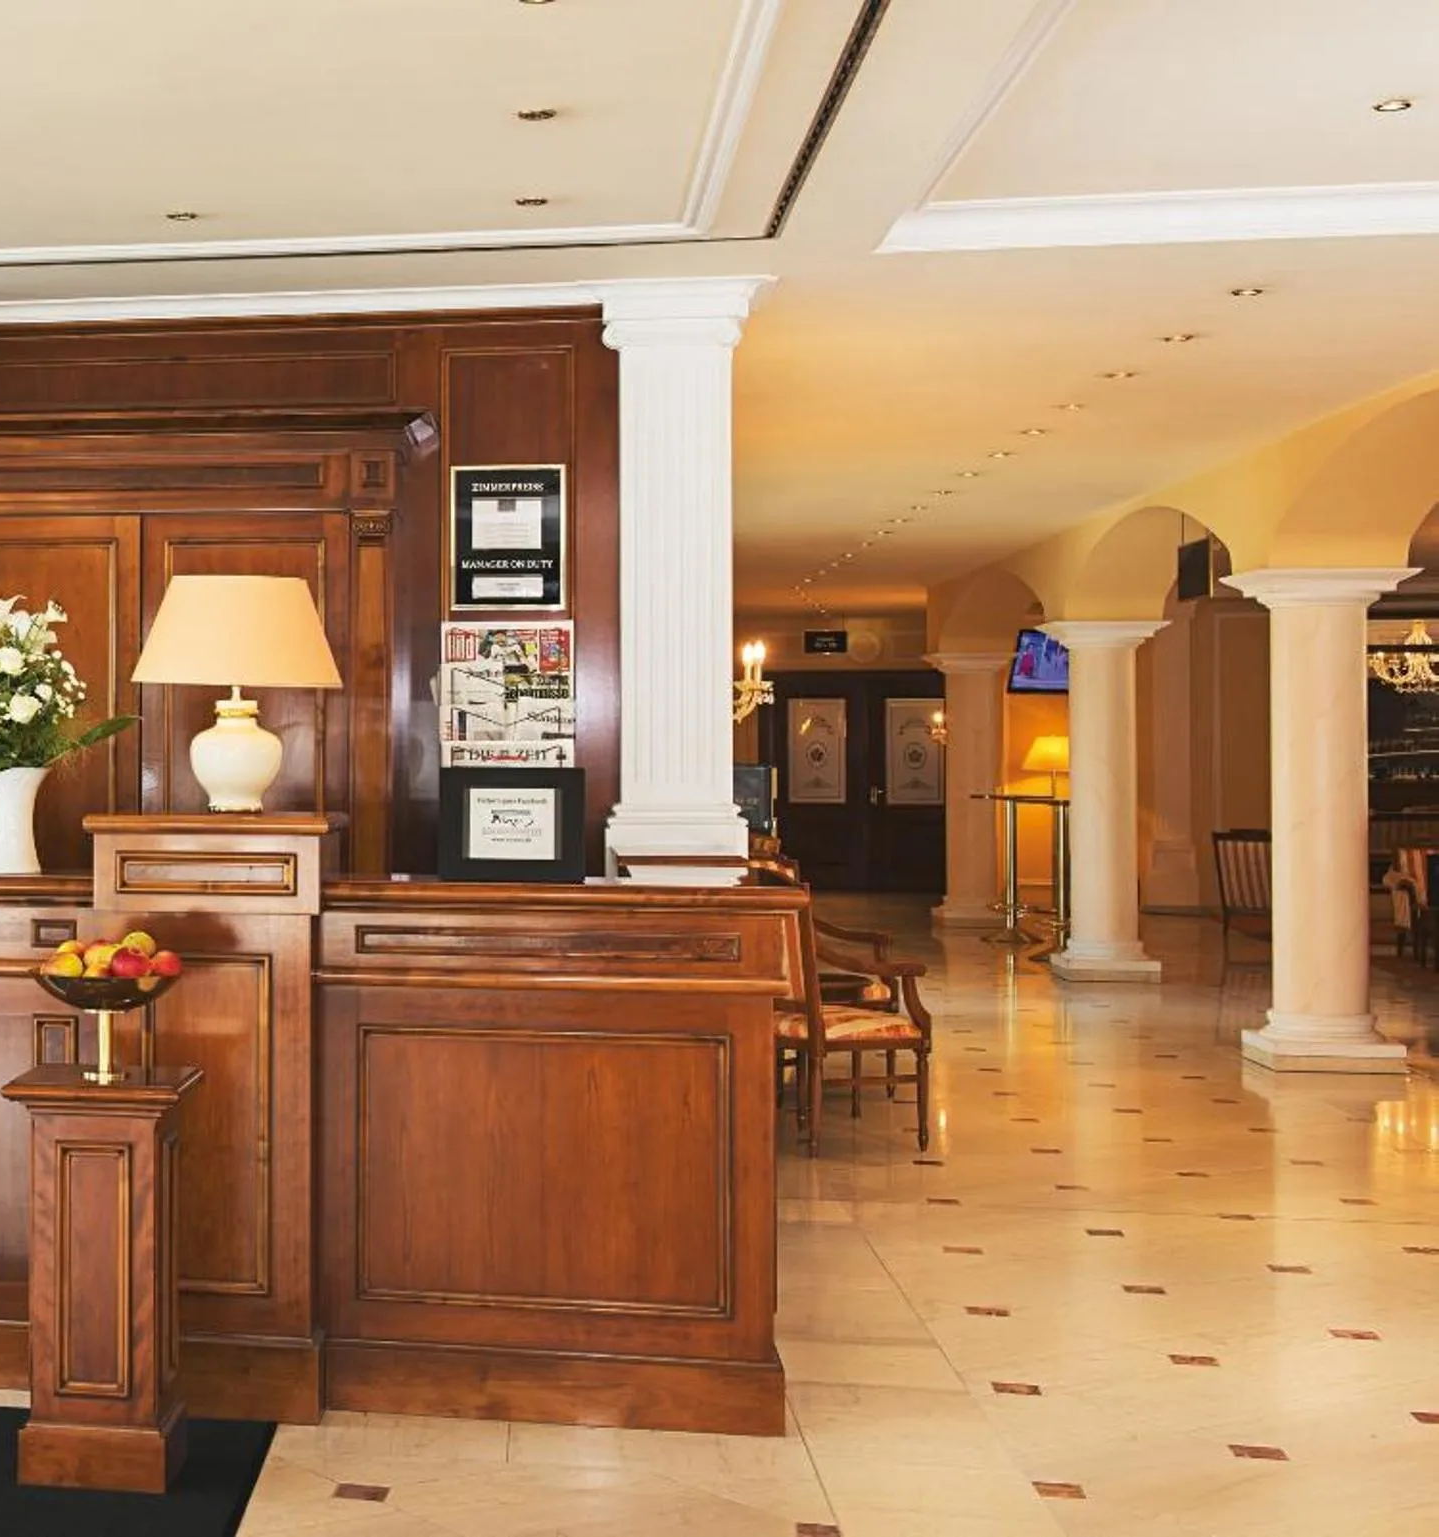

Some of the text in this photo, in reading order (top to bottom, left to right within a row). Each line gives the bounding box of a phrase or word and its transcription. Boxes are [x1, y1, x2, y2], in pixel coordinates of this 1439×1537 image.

[461, 560, 553, 569] MANAGER ON DUTY
